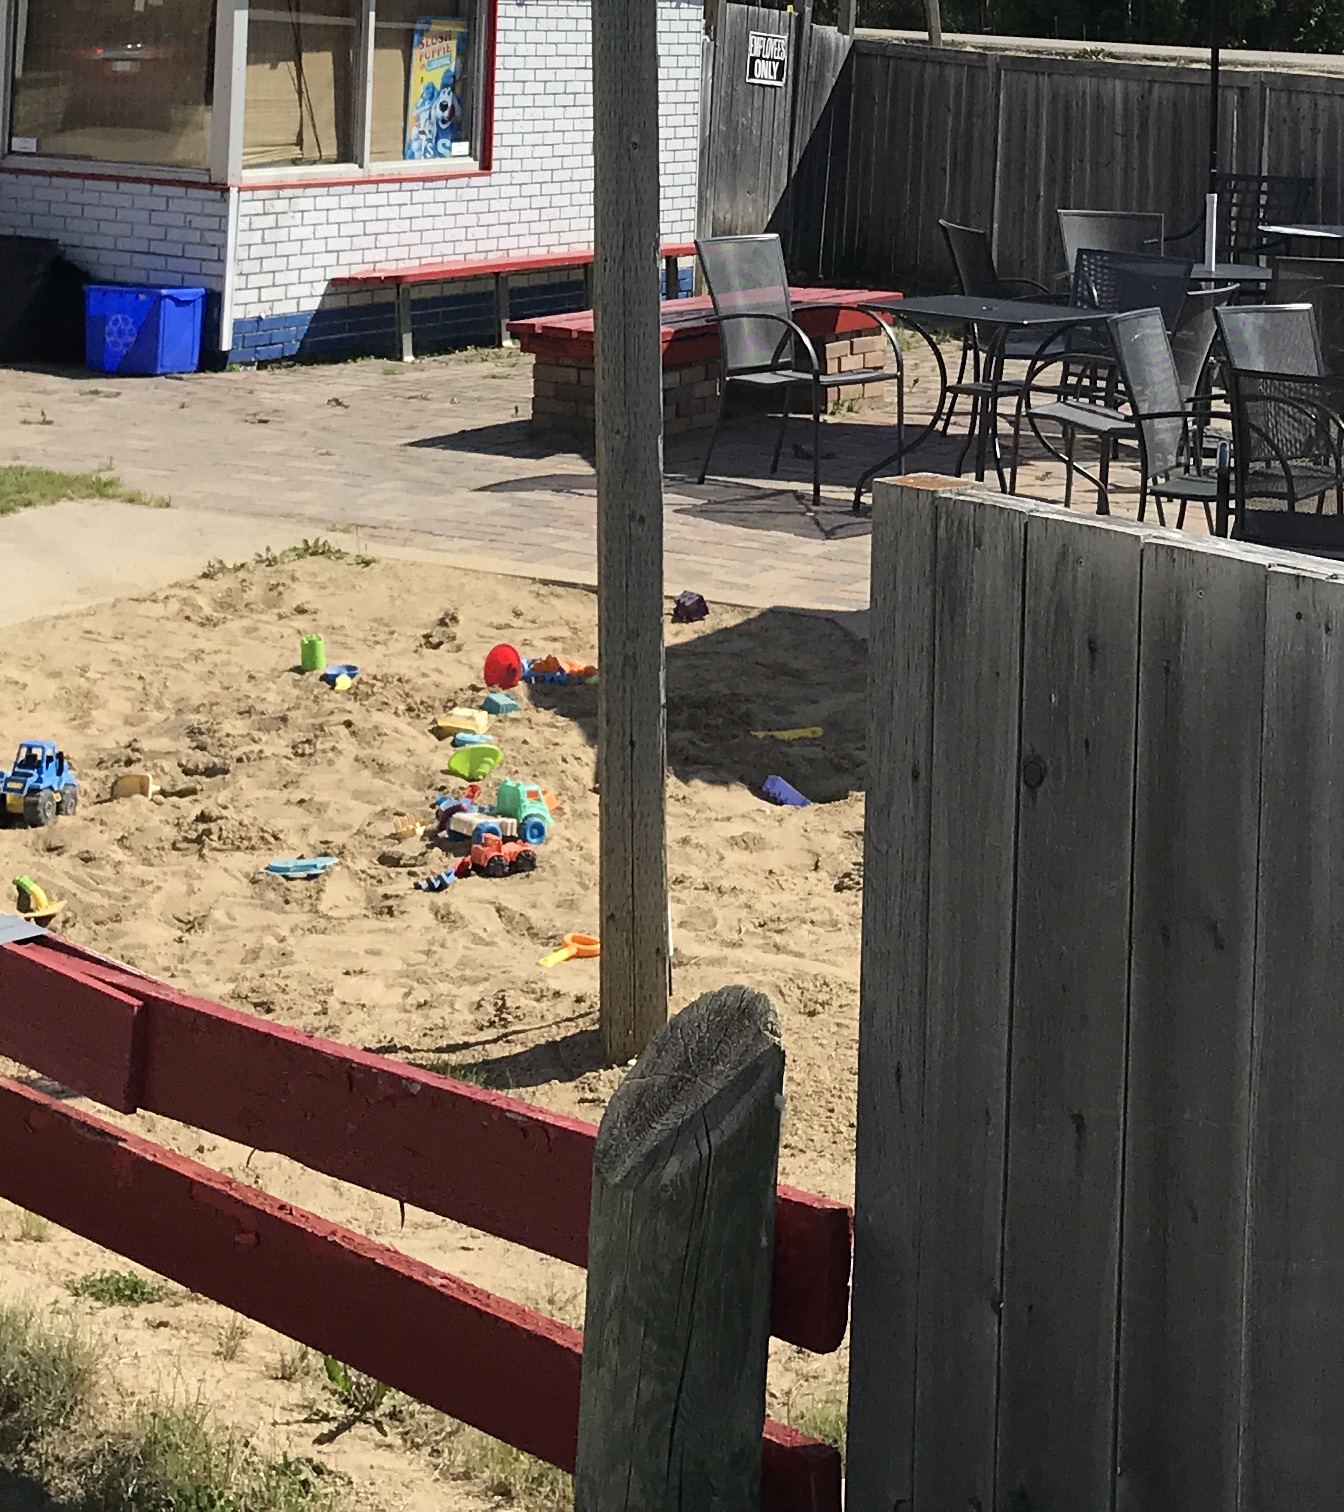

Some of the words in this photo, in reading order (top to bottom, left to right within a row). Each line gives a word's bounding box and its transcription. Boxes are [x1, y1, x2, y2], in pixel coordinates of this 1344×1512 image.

[749, 36, 786, 61] EMPLOYEES
[754, 59, 780, 80] ONLY
[437, 138, 452, 160] S
